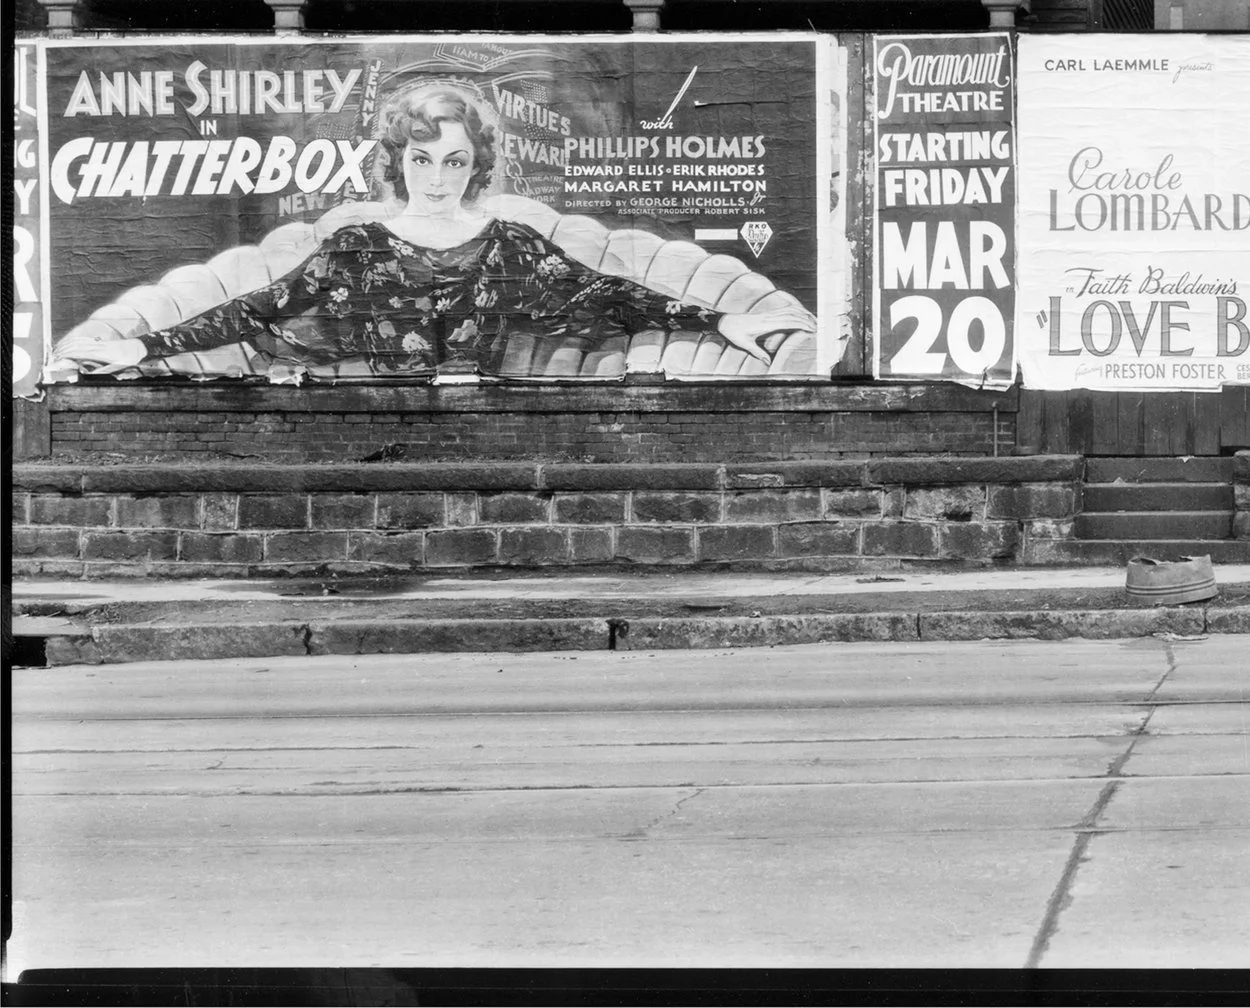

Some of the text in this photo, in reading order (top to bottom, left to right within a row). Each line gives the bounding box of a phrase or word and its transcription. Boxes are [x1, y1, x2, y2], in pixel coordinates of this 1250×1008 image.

[1044, 59, 1087, 72] CARL
[1093, 59, 1169, 71] LAEMMLE
[64, 69, 175, 117] ANNE
[185, 60, 363, 117] SHIRLEY
[362, 60, 382, 127] JENNY
[877, 42, 1010, 119] Paramount
[896, 91, 1004, 113] THEATRE
[200, 120, 218, 135] IN
[564, 135, 766, 159] PHILLIPS HOLMES
[879, 131, 1010, 163] STARTING
[51, 136, 380, 205] CHATTERBOX
[565, 164, 765, 176] EDWARD ELLIS ERIK RHODES
[1068, 146, 1183, 195] Carole
[565, 180, 664, 193] MARGARET
[672, 180, 766, 192] HAMILTON
[884, 166, 1009, 207] FRIDAY
[278, 192, 326, 217] NEW
[565, 200, 612, 208] DIRECTED
[616, 199, 627, 207] BY
[630, 197, 678, 207] GEORGE
[682, 197, 745, 207] NICHOLLS
[659, 207, 700, 215] PRODUCER
[704, 207, 740, 215] ROBERT
[743, 207, 766, 215] SISK
[882, 220, 1011, 290] MAR
[1065, 266, 1132, 298] Faith
[1138, 264, 1240, 296] Baldwin's
[889, 295, 1006, 375] 20
[1105, 363, 1166, 380] PRESTON
[1172, 363, 1227, 380] FOSTER
